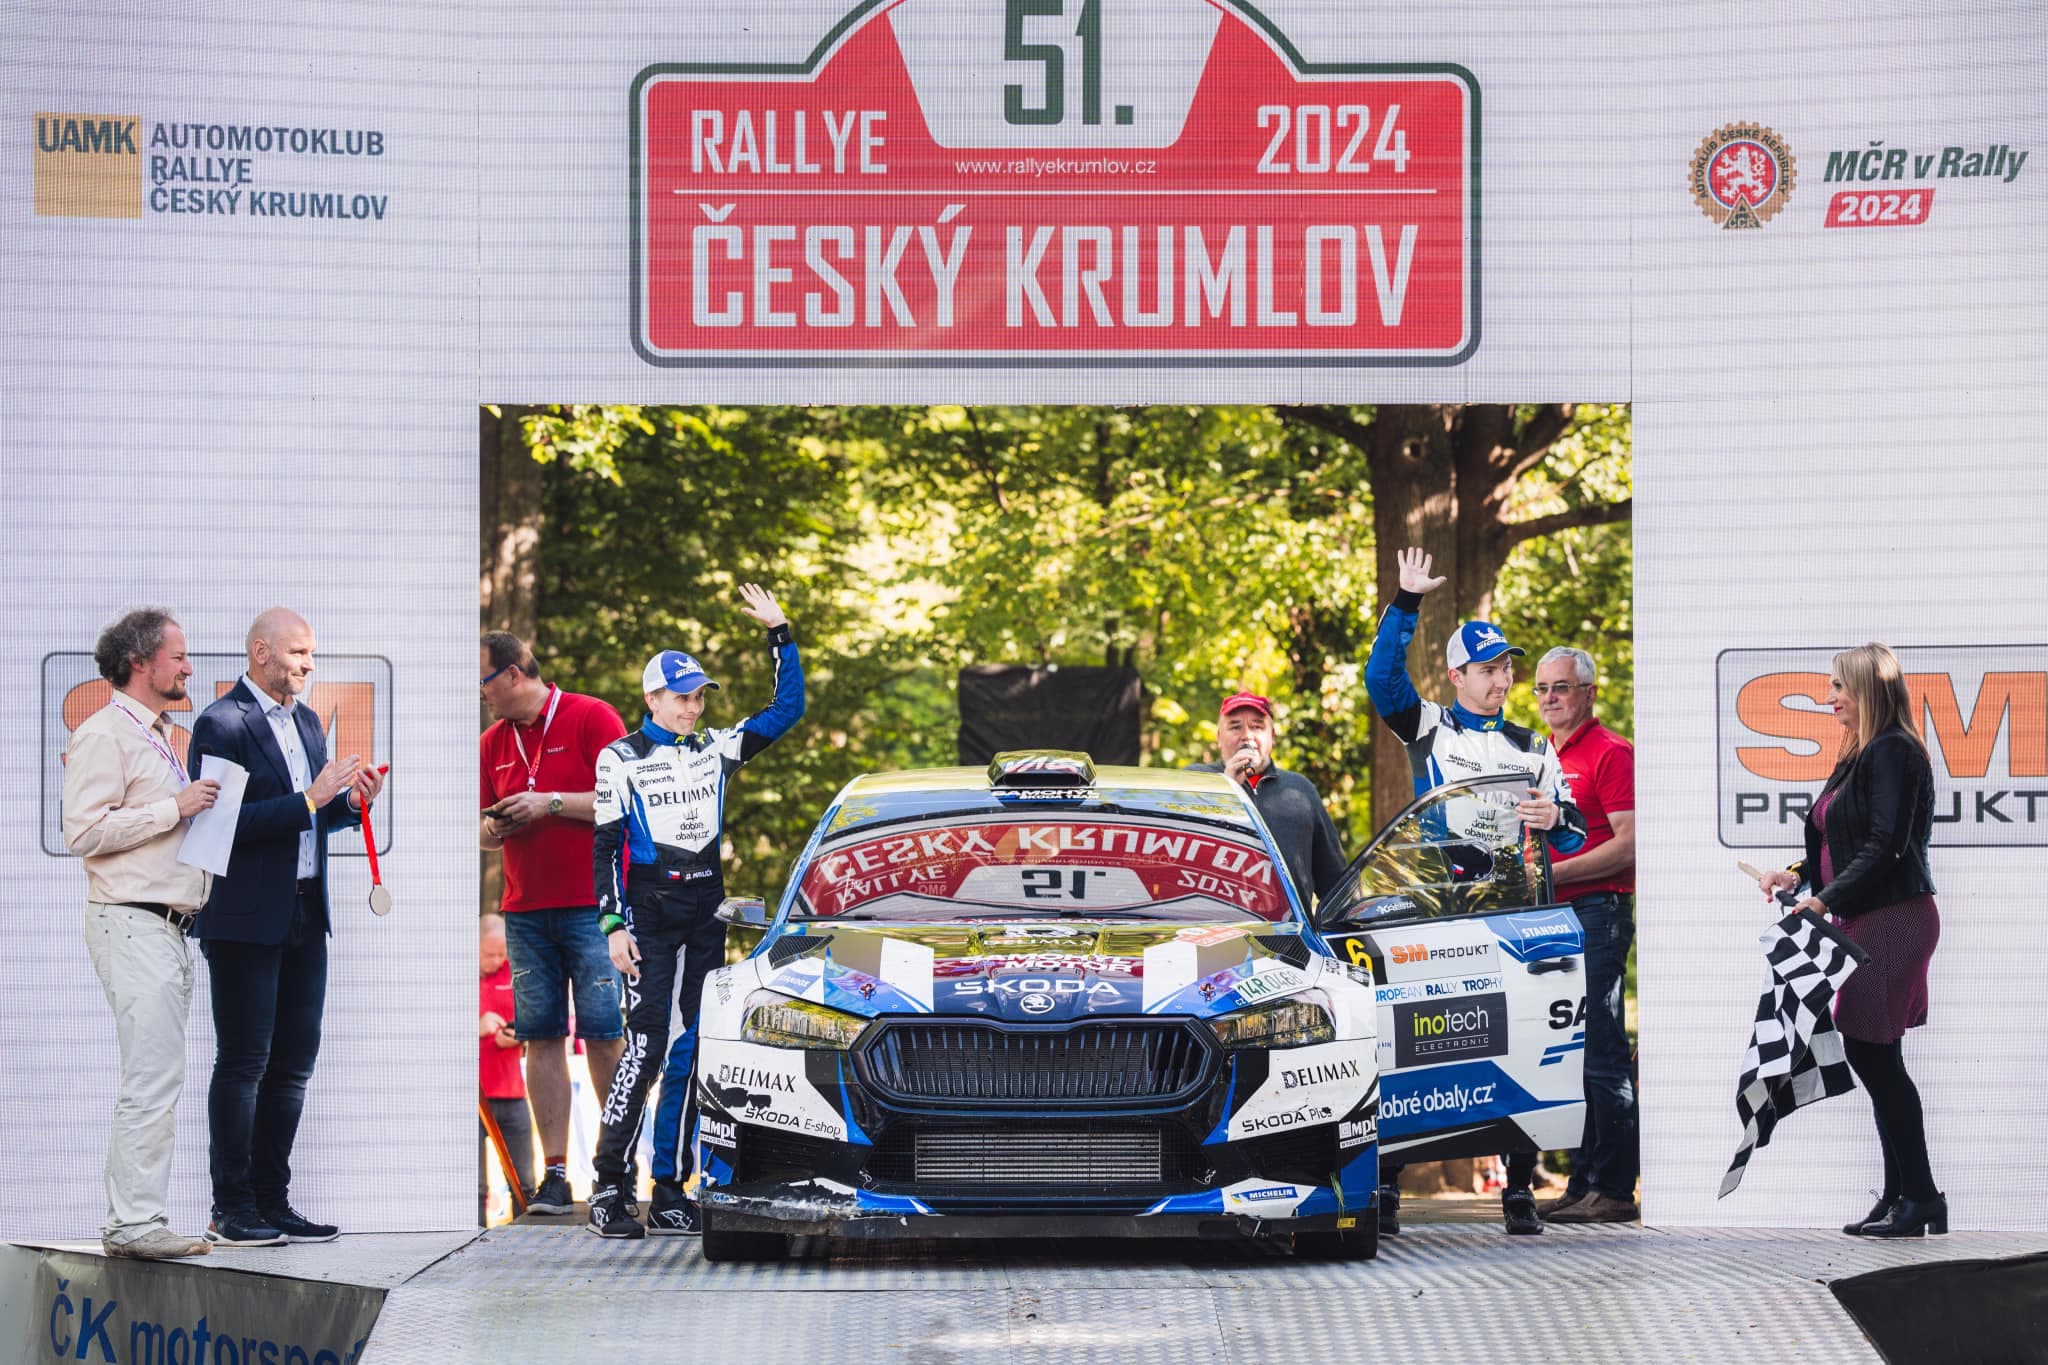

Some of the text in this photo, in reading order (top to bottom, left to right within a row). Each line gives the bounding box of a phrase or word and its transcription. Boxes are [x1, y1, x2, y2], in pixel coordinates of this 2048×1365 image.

[1004, 0, 1133, 125] 51.
[37, 118, 137, 155] UAMK
[150, 123, 385, 156] AUTOMOTOKLUB
[691, 110, 887, 174] RALLYE
[1257, 104, 1410, 174] 2024
[150, 155, 254, 184] RALLYE
[955, 158, 1157, 177] www.rallyekrumlov.cz
[1823, 141, 2029, 183] MČR v Rally
[150, 180, 388, 221] ČESKÝ KRUMLOV
[1837, 194, 1923, 223] 2024
[692, 203, 1419, 328] ČESKÝ KRUMLOV
[1736, 671, 2048, 782] SM
[648, 784, 717, 808] DELIMAX
[1736, 790, 2048, 824] PRUKT
[918, 884, 948, 896] OMP
[1522, 924, 1571, 938] STANDOX
[1005, 960, 1132, 973] MOTOR
[1391, 944, 1489, 964] SM PRODUKT
[1426, 981, 1458, 996] RALLY
[1462, 976, 1503, 993] TROPHY
[1414, 1006, 1489, 1037] inotech
[1416, 1036, 1489, 1052] ELECTRONIC
[719, 1063, 797, 1093] DELIMAX
[1281, 1060, 1361, 1089] DELIMAX
[804, 1118, 841, 1138] E-shop
[1249, 1188, 1294, 1199] MICHELIN
[50, 1278, 118, 1364] ČK
